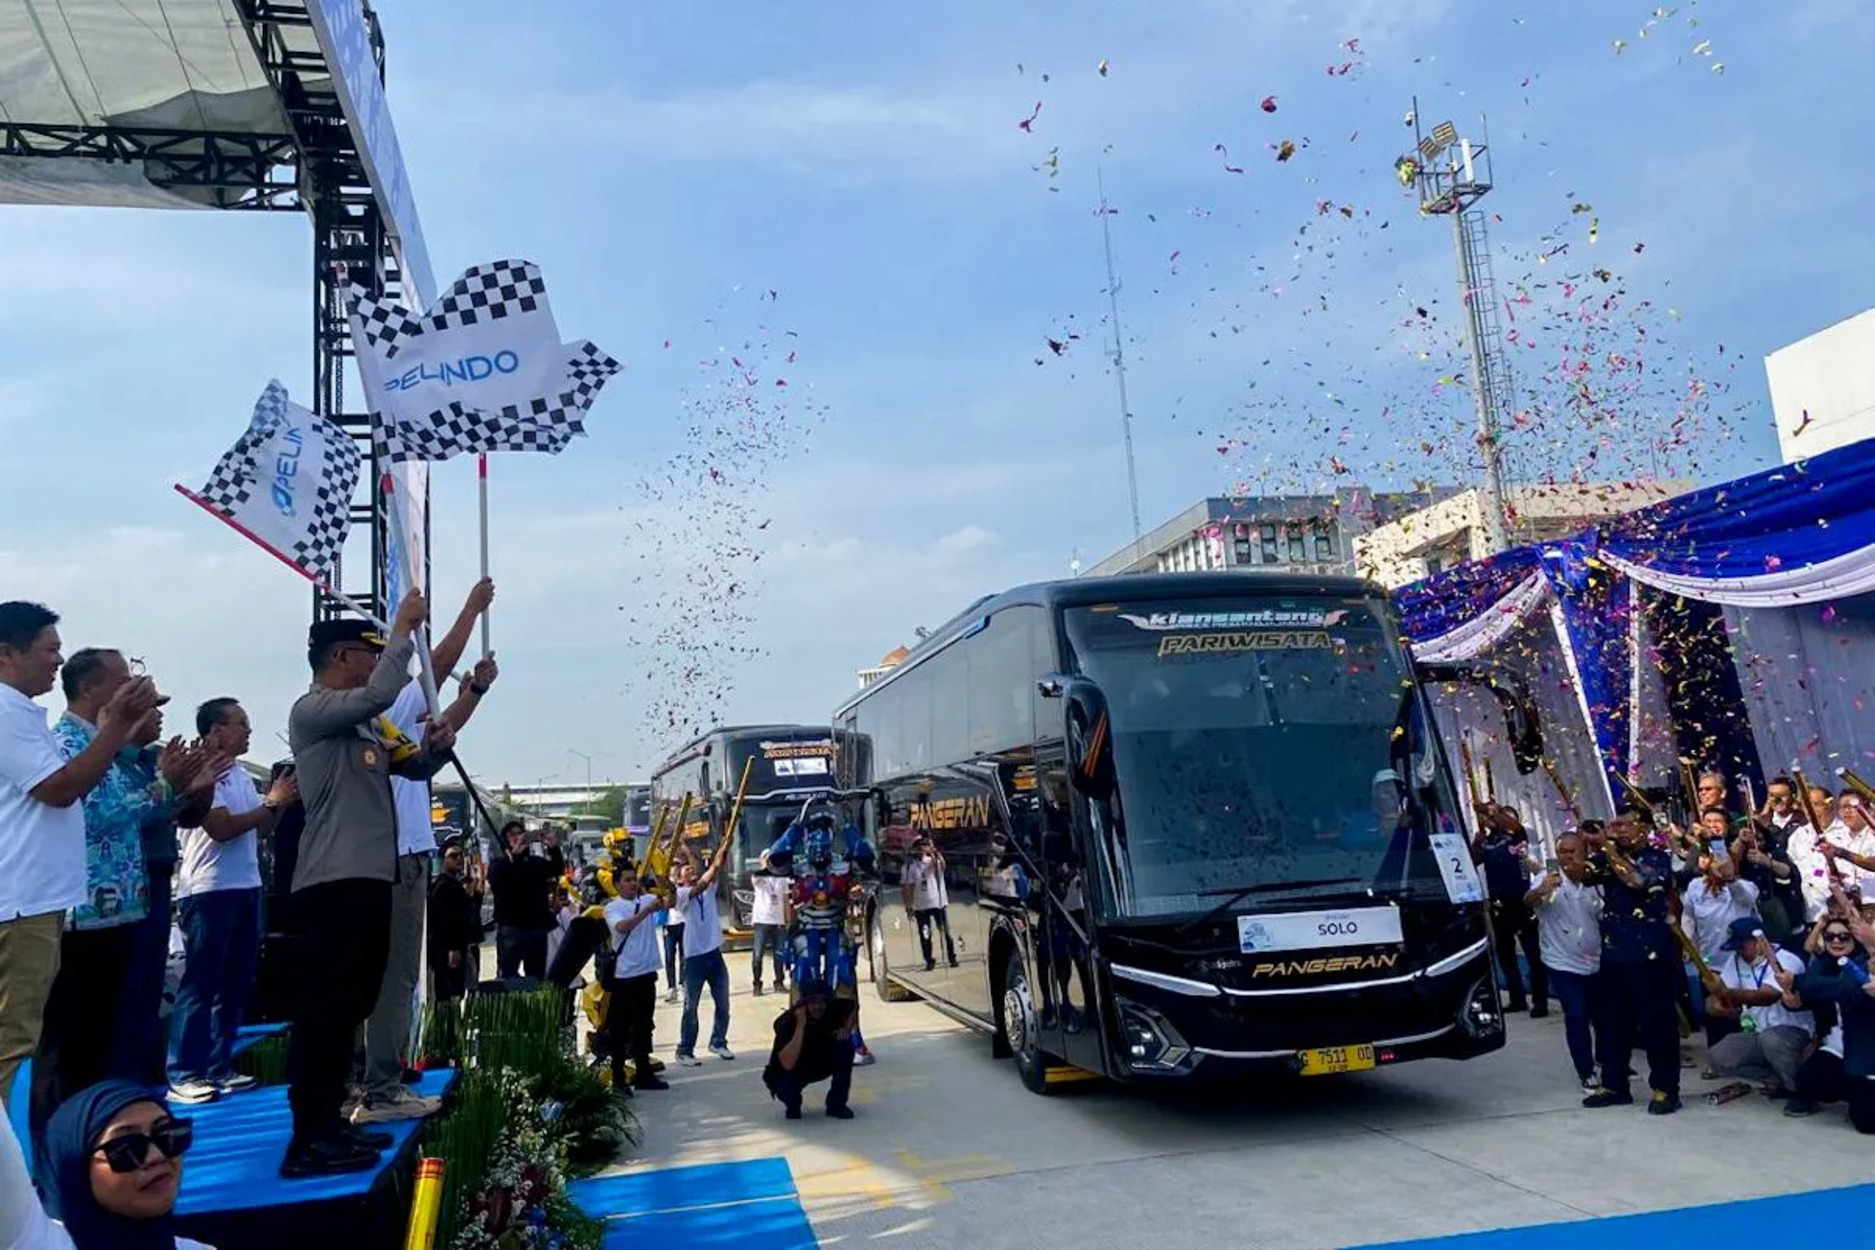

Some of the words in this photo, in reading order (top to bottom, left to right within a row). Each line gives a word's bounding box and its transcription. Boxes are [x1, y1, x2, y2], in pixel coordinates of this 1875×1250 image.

[1160, 631, 1332, 654] PARIWISATA
[910, 793, 991, 829] PANGERAN
[1451, 857, 1462, 873] 2
[1318, 921, 1358, 936] SOLO
[1252, 953, 1398, 978] PANGERAN
